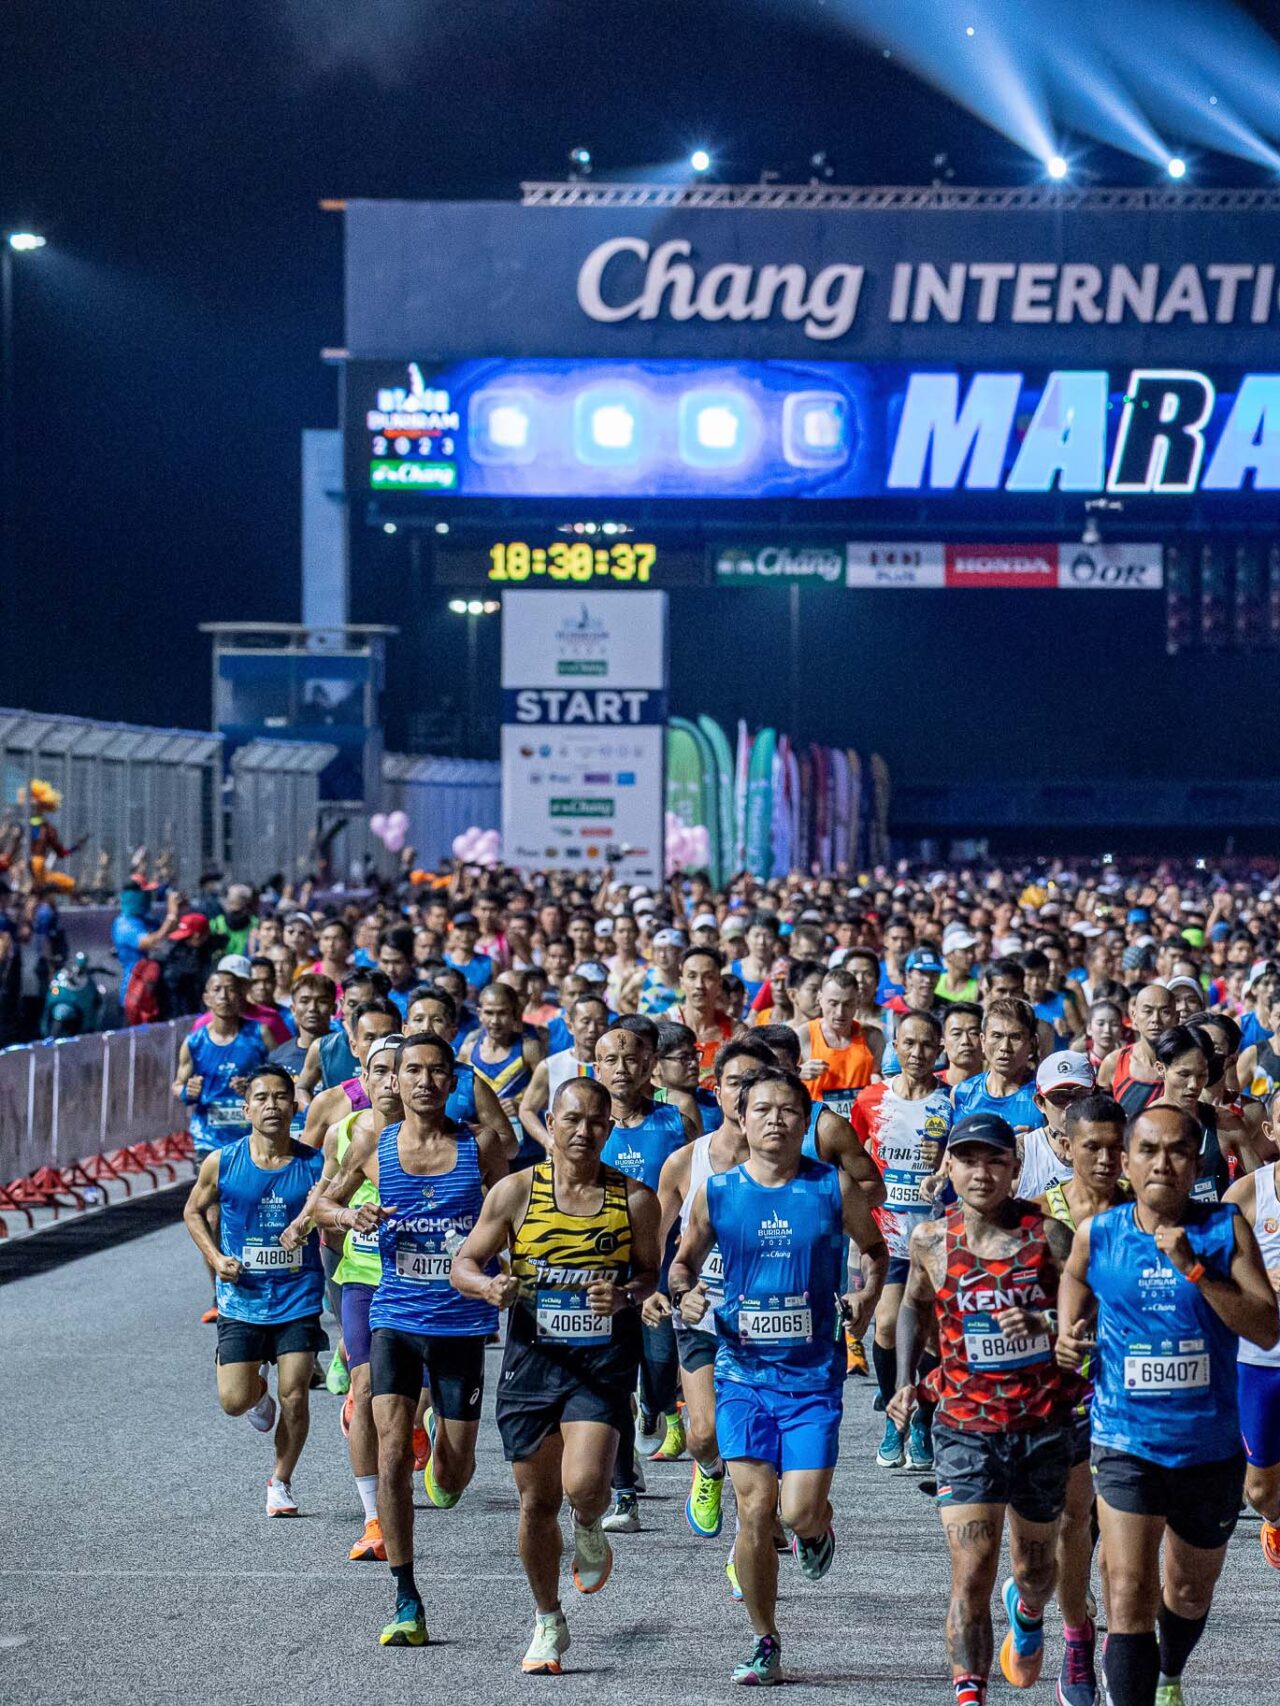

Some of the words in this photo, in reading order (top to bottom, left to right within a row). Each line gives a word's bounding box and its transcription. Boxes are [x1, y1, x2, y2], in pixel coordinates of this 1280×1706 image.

[577, 237, 865, 340] Chang
[756, 546, 843, 580] Chang
[954, 557, 1053, 575] HONDA
[516, 690, 649, 723] START
[387, 1215, 473, 1233] PAKCHONG
[256, 1250, 294, 1265] 41805
[412, 1258, 452, 1275] 41178
[956, 1284, 1047, 1312] KENYA
[550, 1314, 603, 1332] 40652
[751, 1315, 803, 1334] 42065
[1141, 1361, 1199, 1382] 69407
